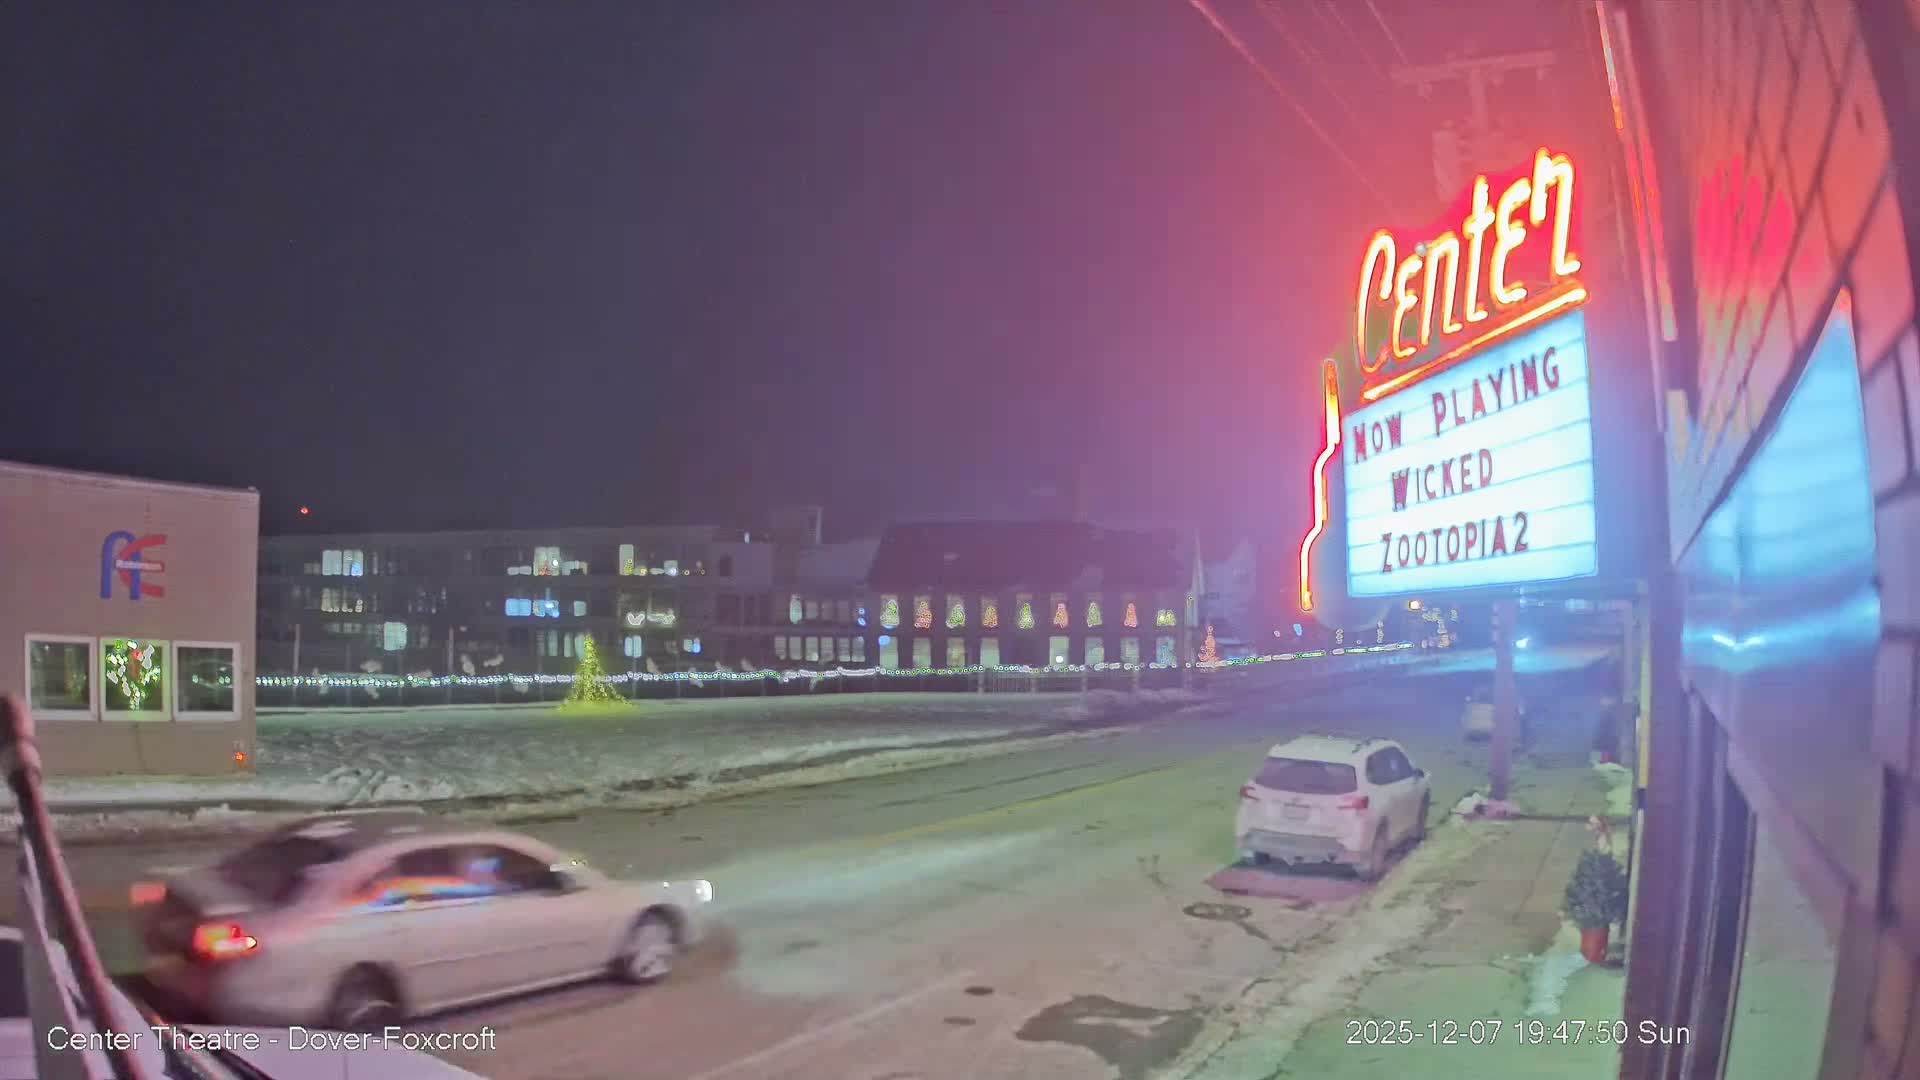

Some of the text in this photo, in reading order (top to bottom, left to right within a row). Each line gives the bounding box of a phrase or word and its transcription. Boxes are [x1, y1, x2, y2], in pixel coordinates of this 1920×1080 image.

[1353, 346, 1560, 464] NOW PLAYING
[1391, 448, 1493, 512] WICKED
